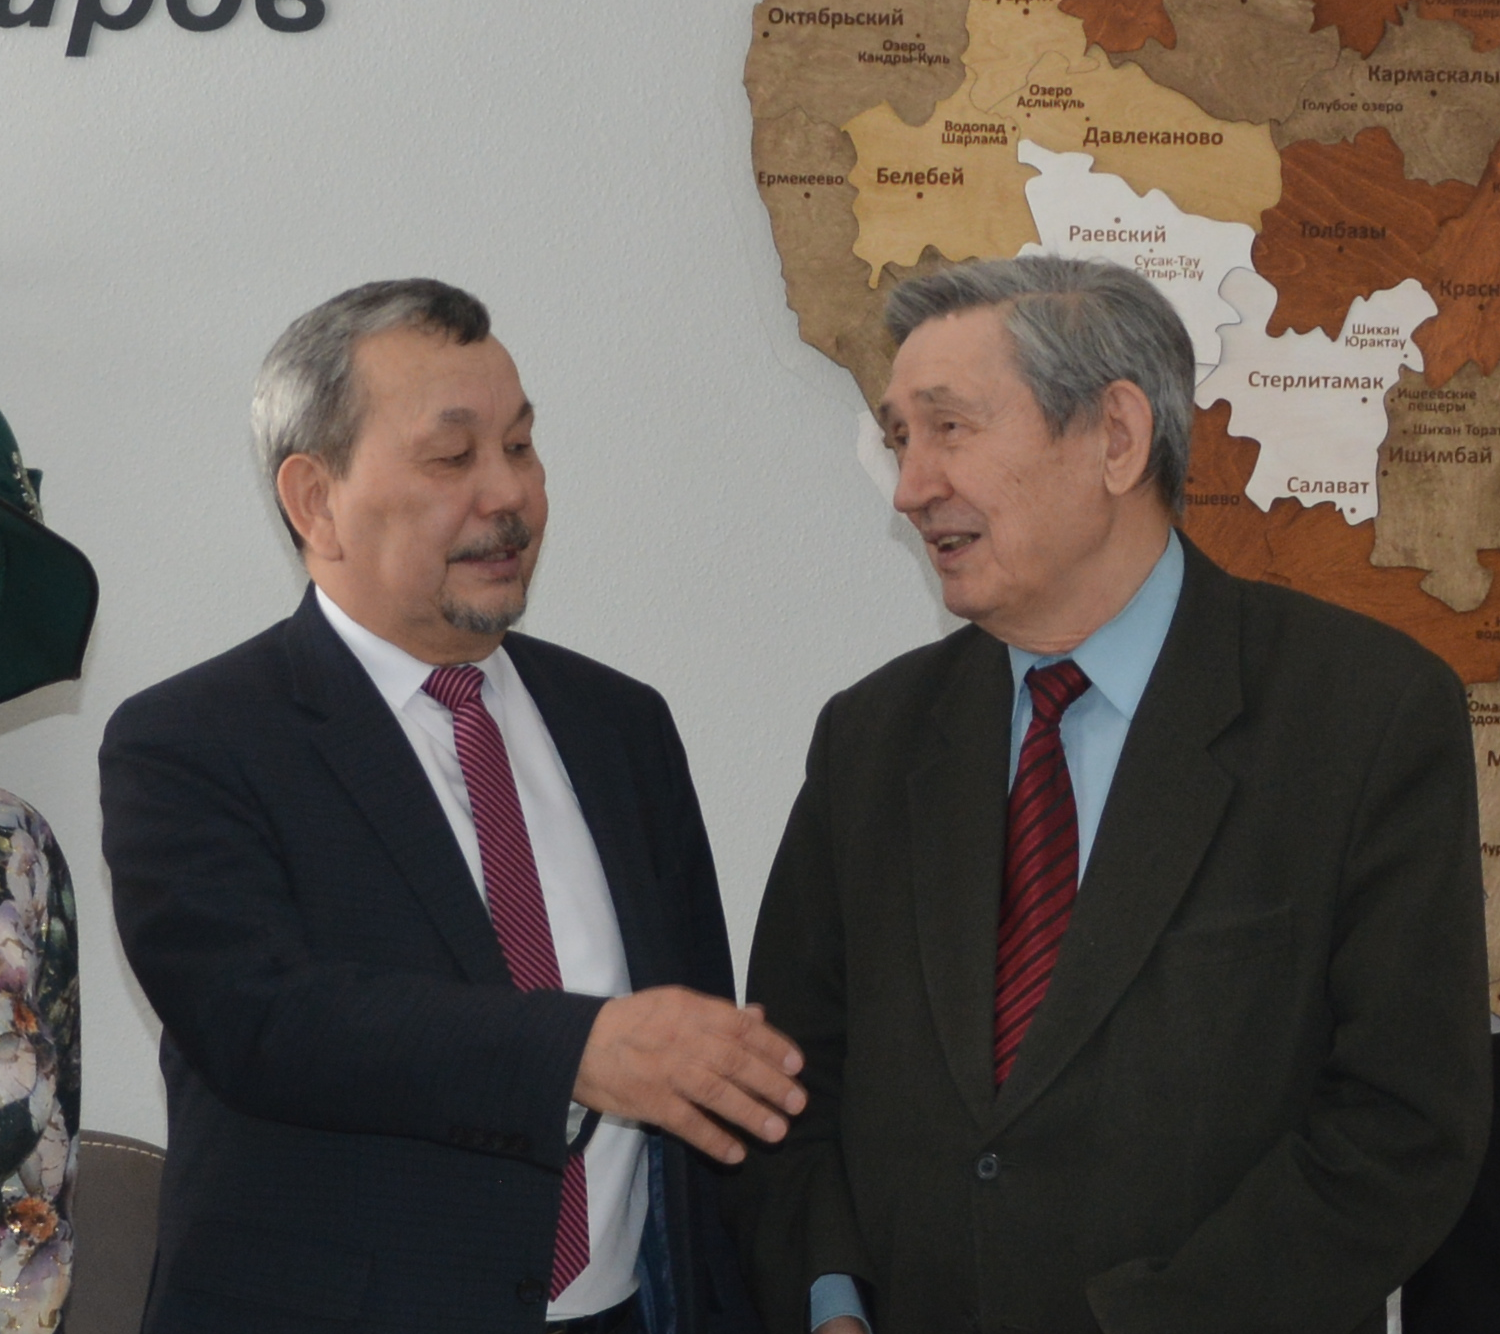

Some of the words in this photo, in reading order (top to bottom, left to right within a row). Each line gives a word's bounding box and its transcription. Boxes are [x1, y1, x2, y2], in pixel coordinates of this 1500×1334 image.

[768, 7, 904, 27] Октябрьский
[882, 40, 926, 52] Озеро
[858, 51, 950, 67] Кандры-Куль
[1368, 67, 1500, 86] Кармаскалы
[1029, 85, 1073, 97] Озеро
[1017, 97, 1084, 110] Аслыкуль
[1302, 99, 1357, 113] Голубое
[1362, 101, 1403, 114] озеро
[944, 121, 1006, 136] Водопад
[942, 133, 1008, 146] Шарлама
[1083, 128, 1224, 146] Давлеканово
[759, 172, 844, 186] Ермекеево
[877, 168, 964, 186] Белебей
[1069, 225, 1167, 243] Раевский
[1301, 225, 1386, 240] Толбазы
[1134, 254, 1201, 269] Сусак-Тау
[1352, 324, 1399, 336] Шихан
[1344, 336, 1407, 350] Юрактау
[1248, 371, 1384, 391] Стерлитамак
[1398, 389, 1477, 401] Ишеевские
[1408, 401, 1466, 413] пещеры
[1413, 424, 1462, 436] Шихан
[1388, 446, 1493, 465] Ишимбай
[1287, 477, 1370, 494] Салават
